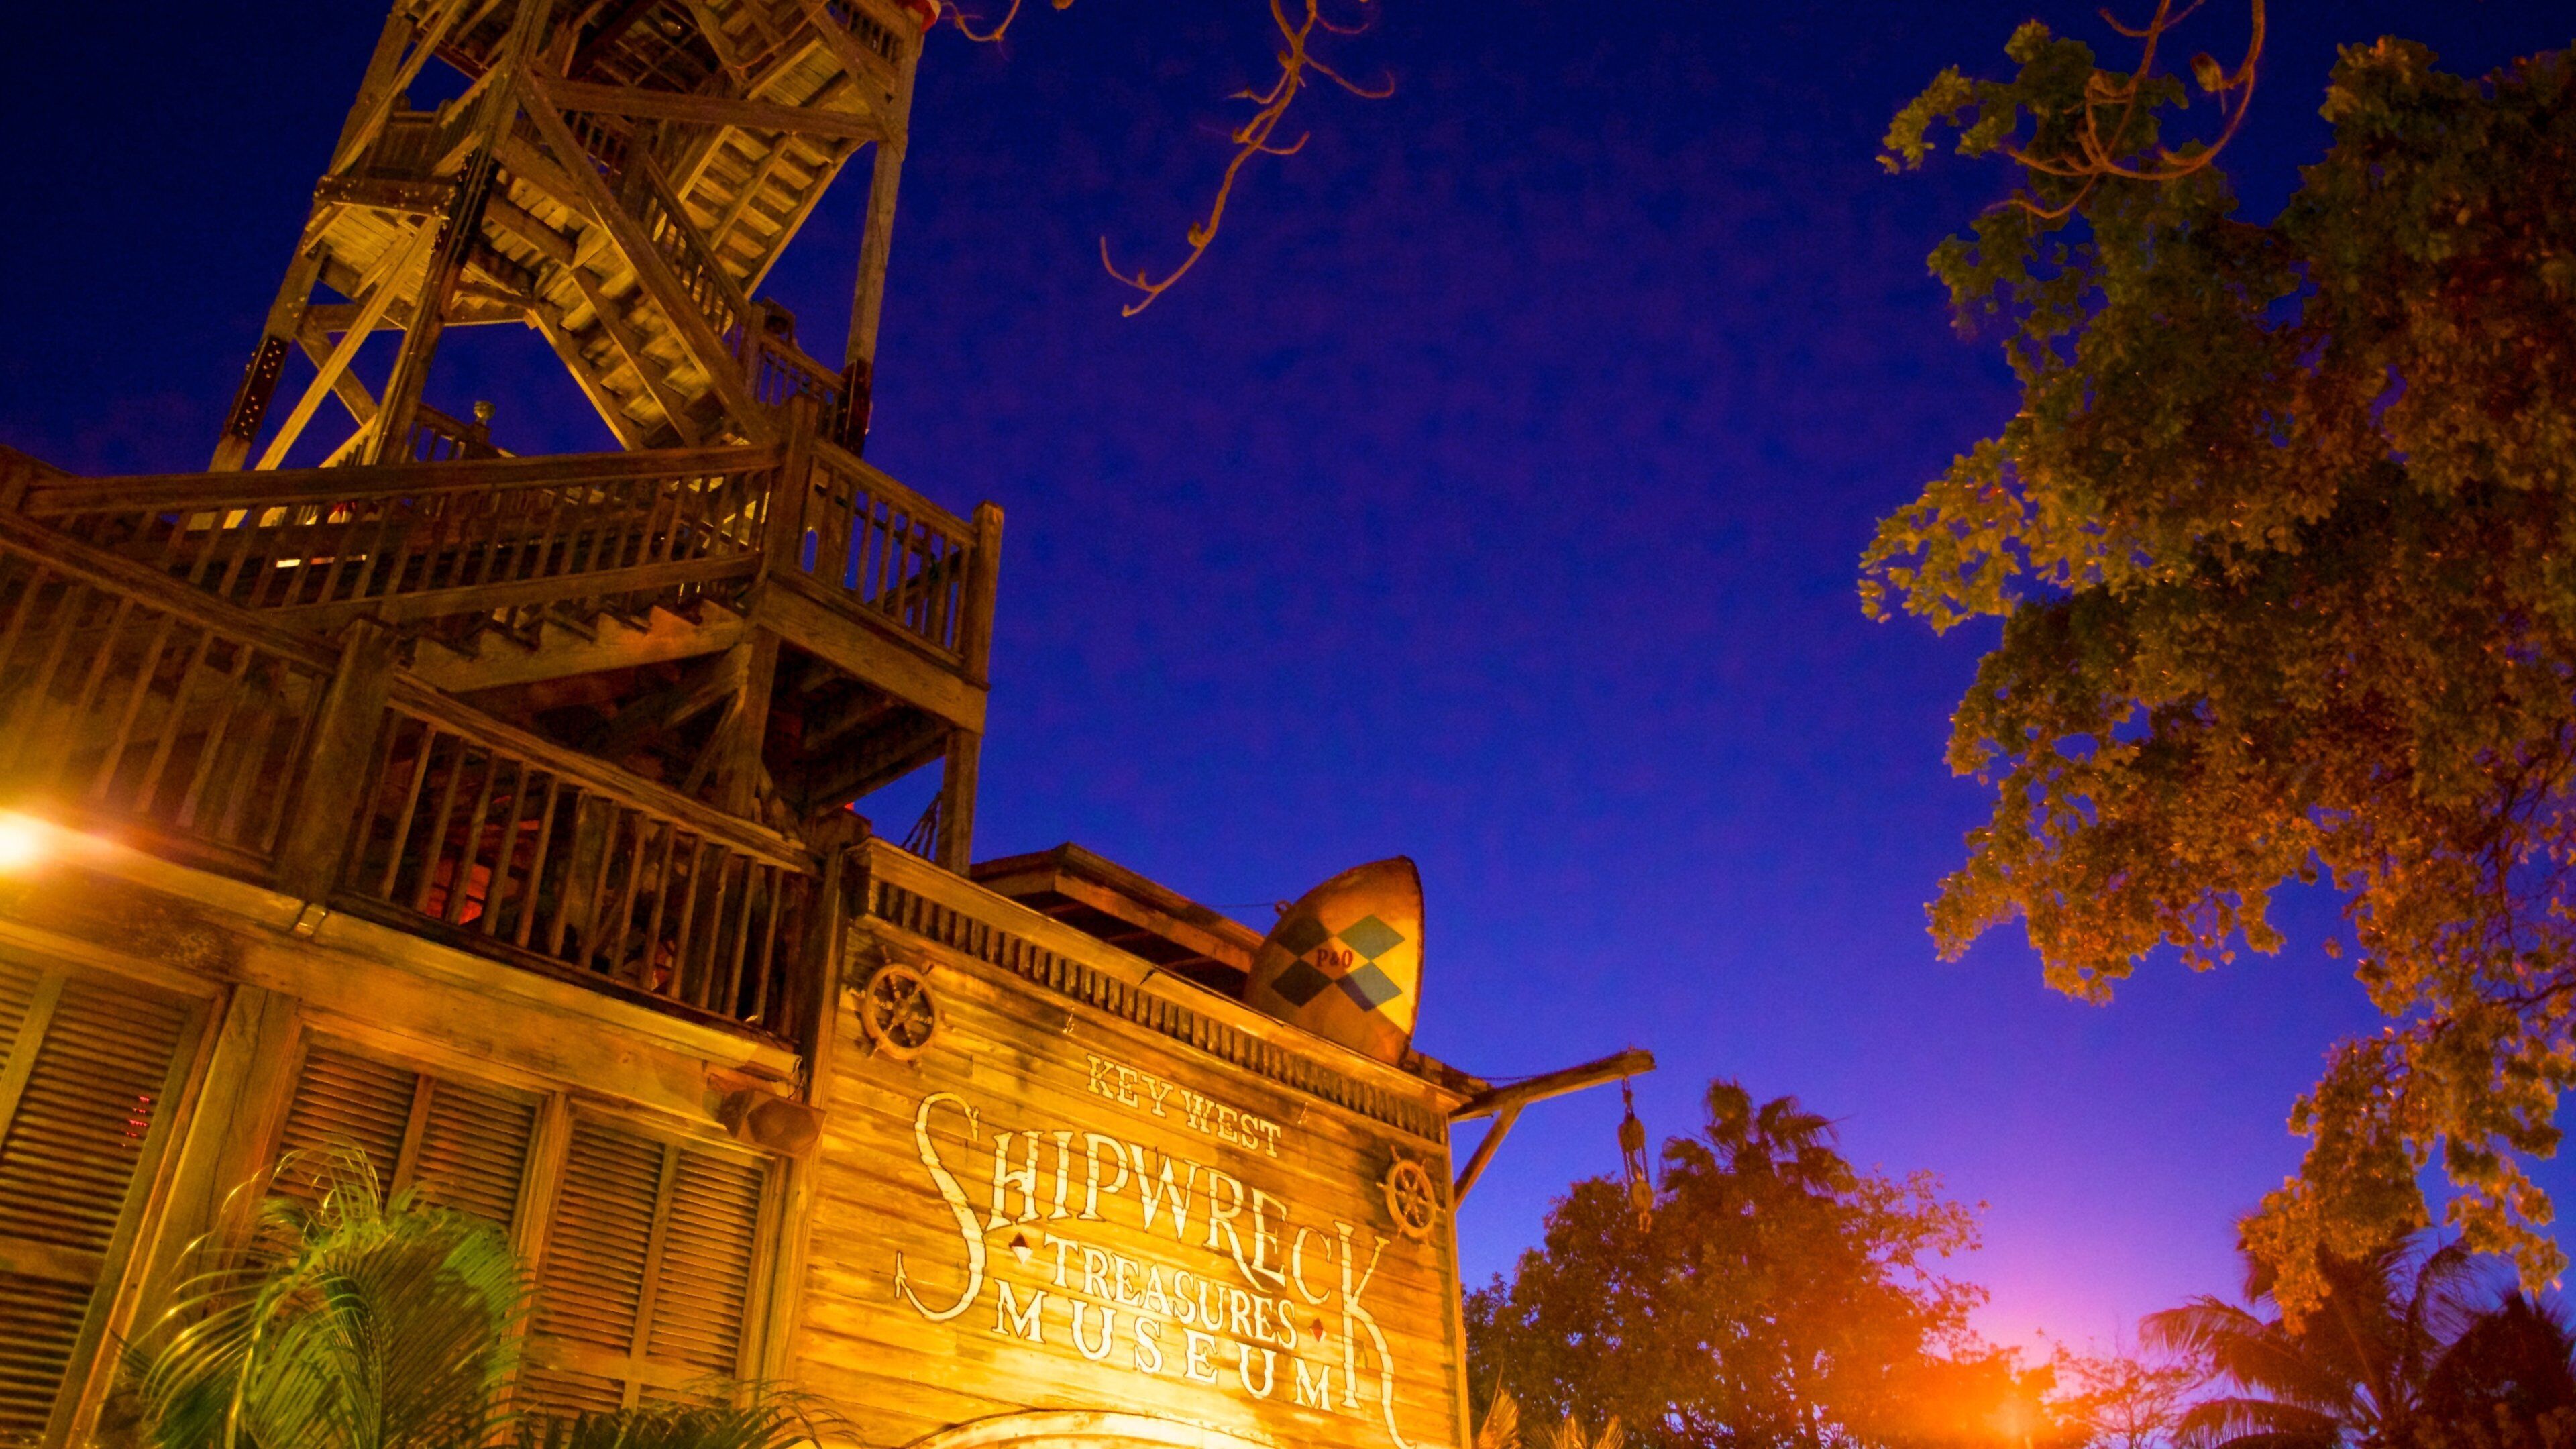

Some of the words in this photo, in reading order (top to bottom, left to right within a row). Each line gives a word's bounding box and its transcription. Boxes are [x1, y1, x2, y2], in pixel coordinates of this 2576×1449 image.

[1087, 1054, 1173, 1118] KEY
[1180, 1089, 1281, 1158] WEST
[894, 1092, 1417, 1449] SHIPWRECK
[1044, 1232, 1297, 1350] TREASURES
[991, 1278, 1334, 1412] MUSEUM
